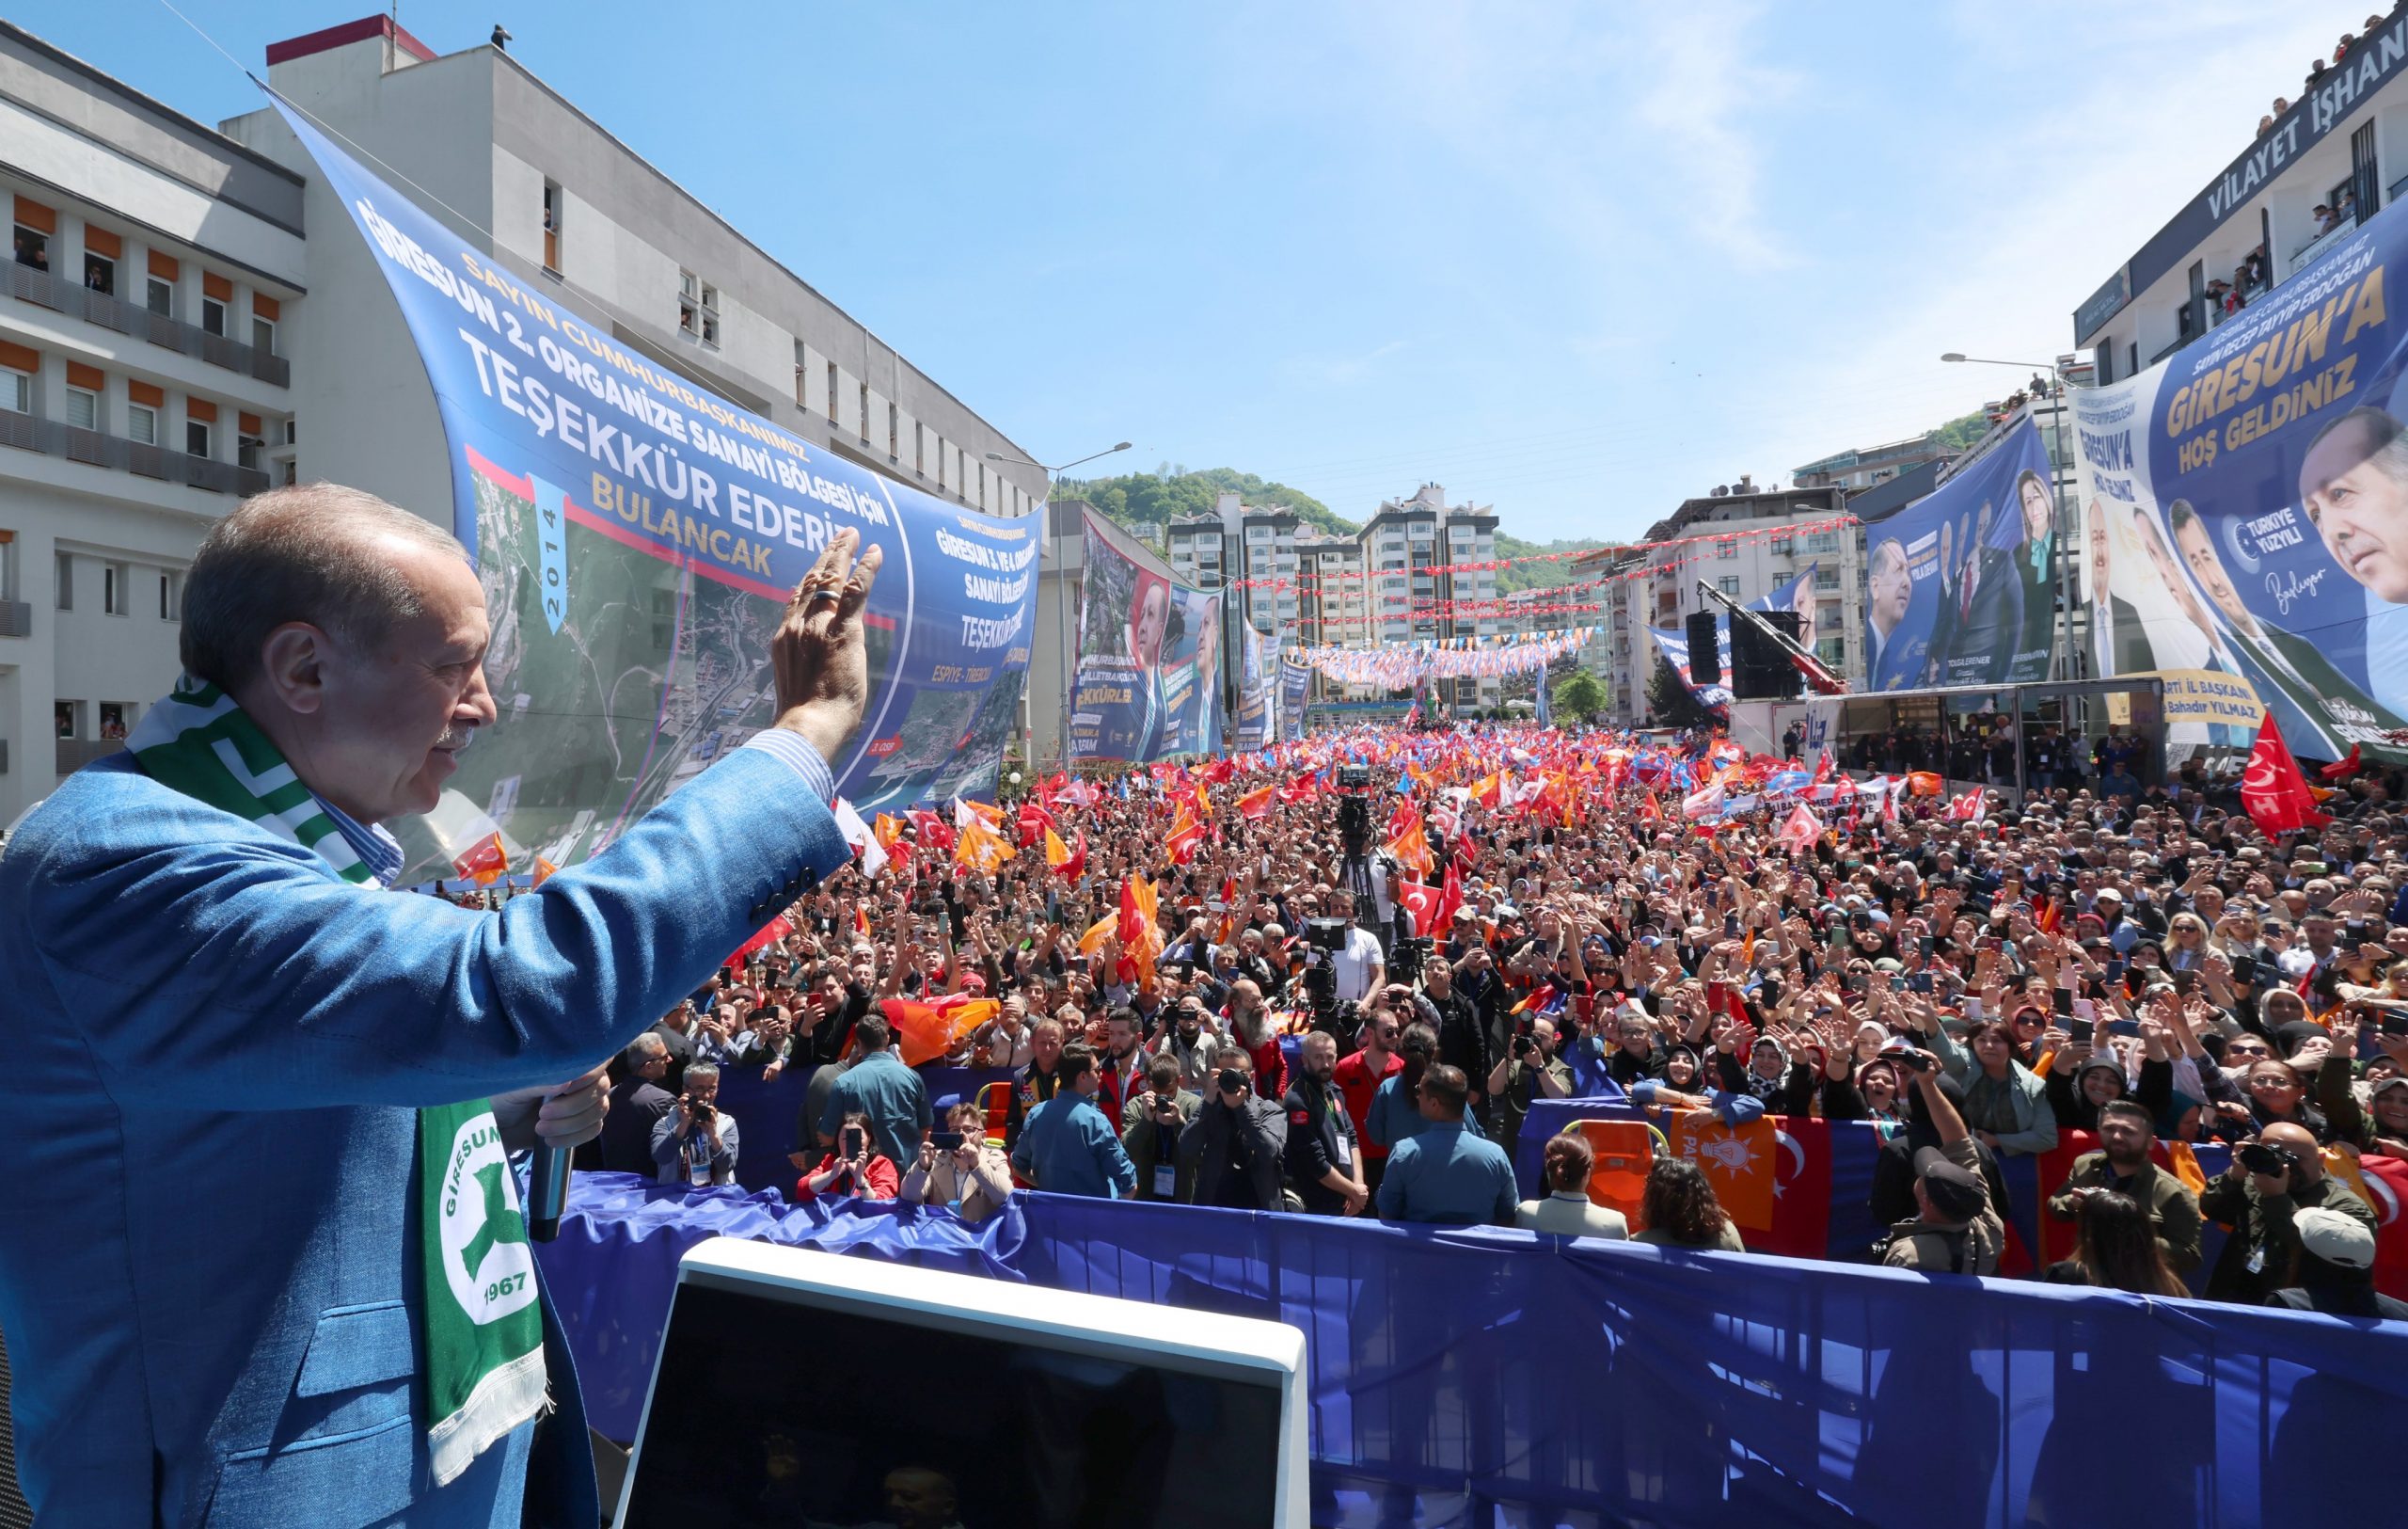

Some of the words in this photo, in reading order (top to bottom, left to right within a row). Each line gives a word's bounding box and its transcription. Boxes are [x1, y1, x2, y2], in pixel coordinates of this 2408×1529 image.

[2209, 115, 2300, 220] VİLAYET
[2167, 264, 2386, 438] GİRESUN'A
[2221, 325, 2258, 359] RECEP
[2258, 298, 2299, 338] TAYYİP
[2299, 247, 2376, 313] ERDOĞAN
[356, 197, 500, 334] GİRESUN
[502, 311, 536, 358] 2.
[538, 335, 688, 445] ORGANİZE
[689, 420, 778, 484] SANAYİ
[775, 458, 857, 515] BÖLGESİ
[851, 486, 889, 528] İÇİN
[461, 252, 559, 332] SAYIN
[562, 320, 811, 463] CUMHURBAŞKANIMIZ
[458, 327, 721, 518] TEŞEKKÜR
[2178, 429, 2217, 475] HOŞ
[2225, 352, 2358, 452] GELDİNİZ
[542, 507, 561, 617] 2014
[592, 471, 773, 578] BULANCAK
[935, 526, 990, 568] GİRESUN
[961, 613, 1011, 654] TEŞEKKÜR
[964, 572, 1001, 604] SANAYİ
[931, 662, 962, 683] ESPİYE
[2168, 700, 2207, 713] Bahadır
[2210, 701, 2259, 720] YILMAZ
[2187, 677, 2197, 693] İL
[2198, 680, 2252, 700] BAŞKANI
[446, 1126, 501, 1218] GİRESUN
[484, 1271, 527, 1305] 1967
